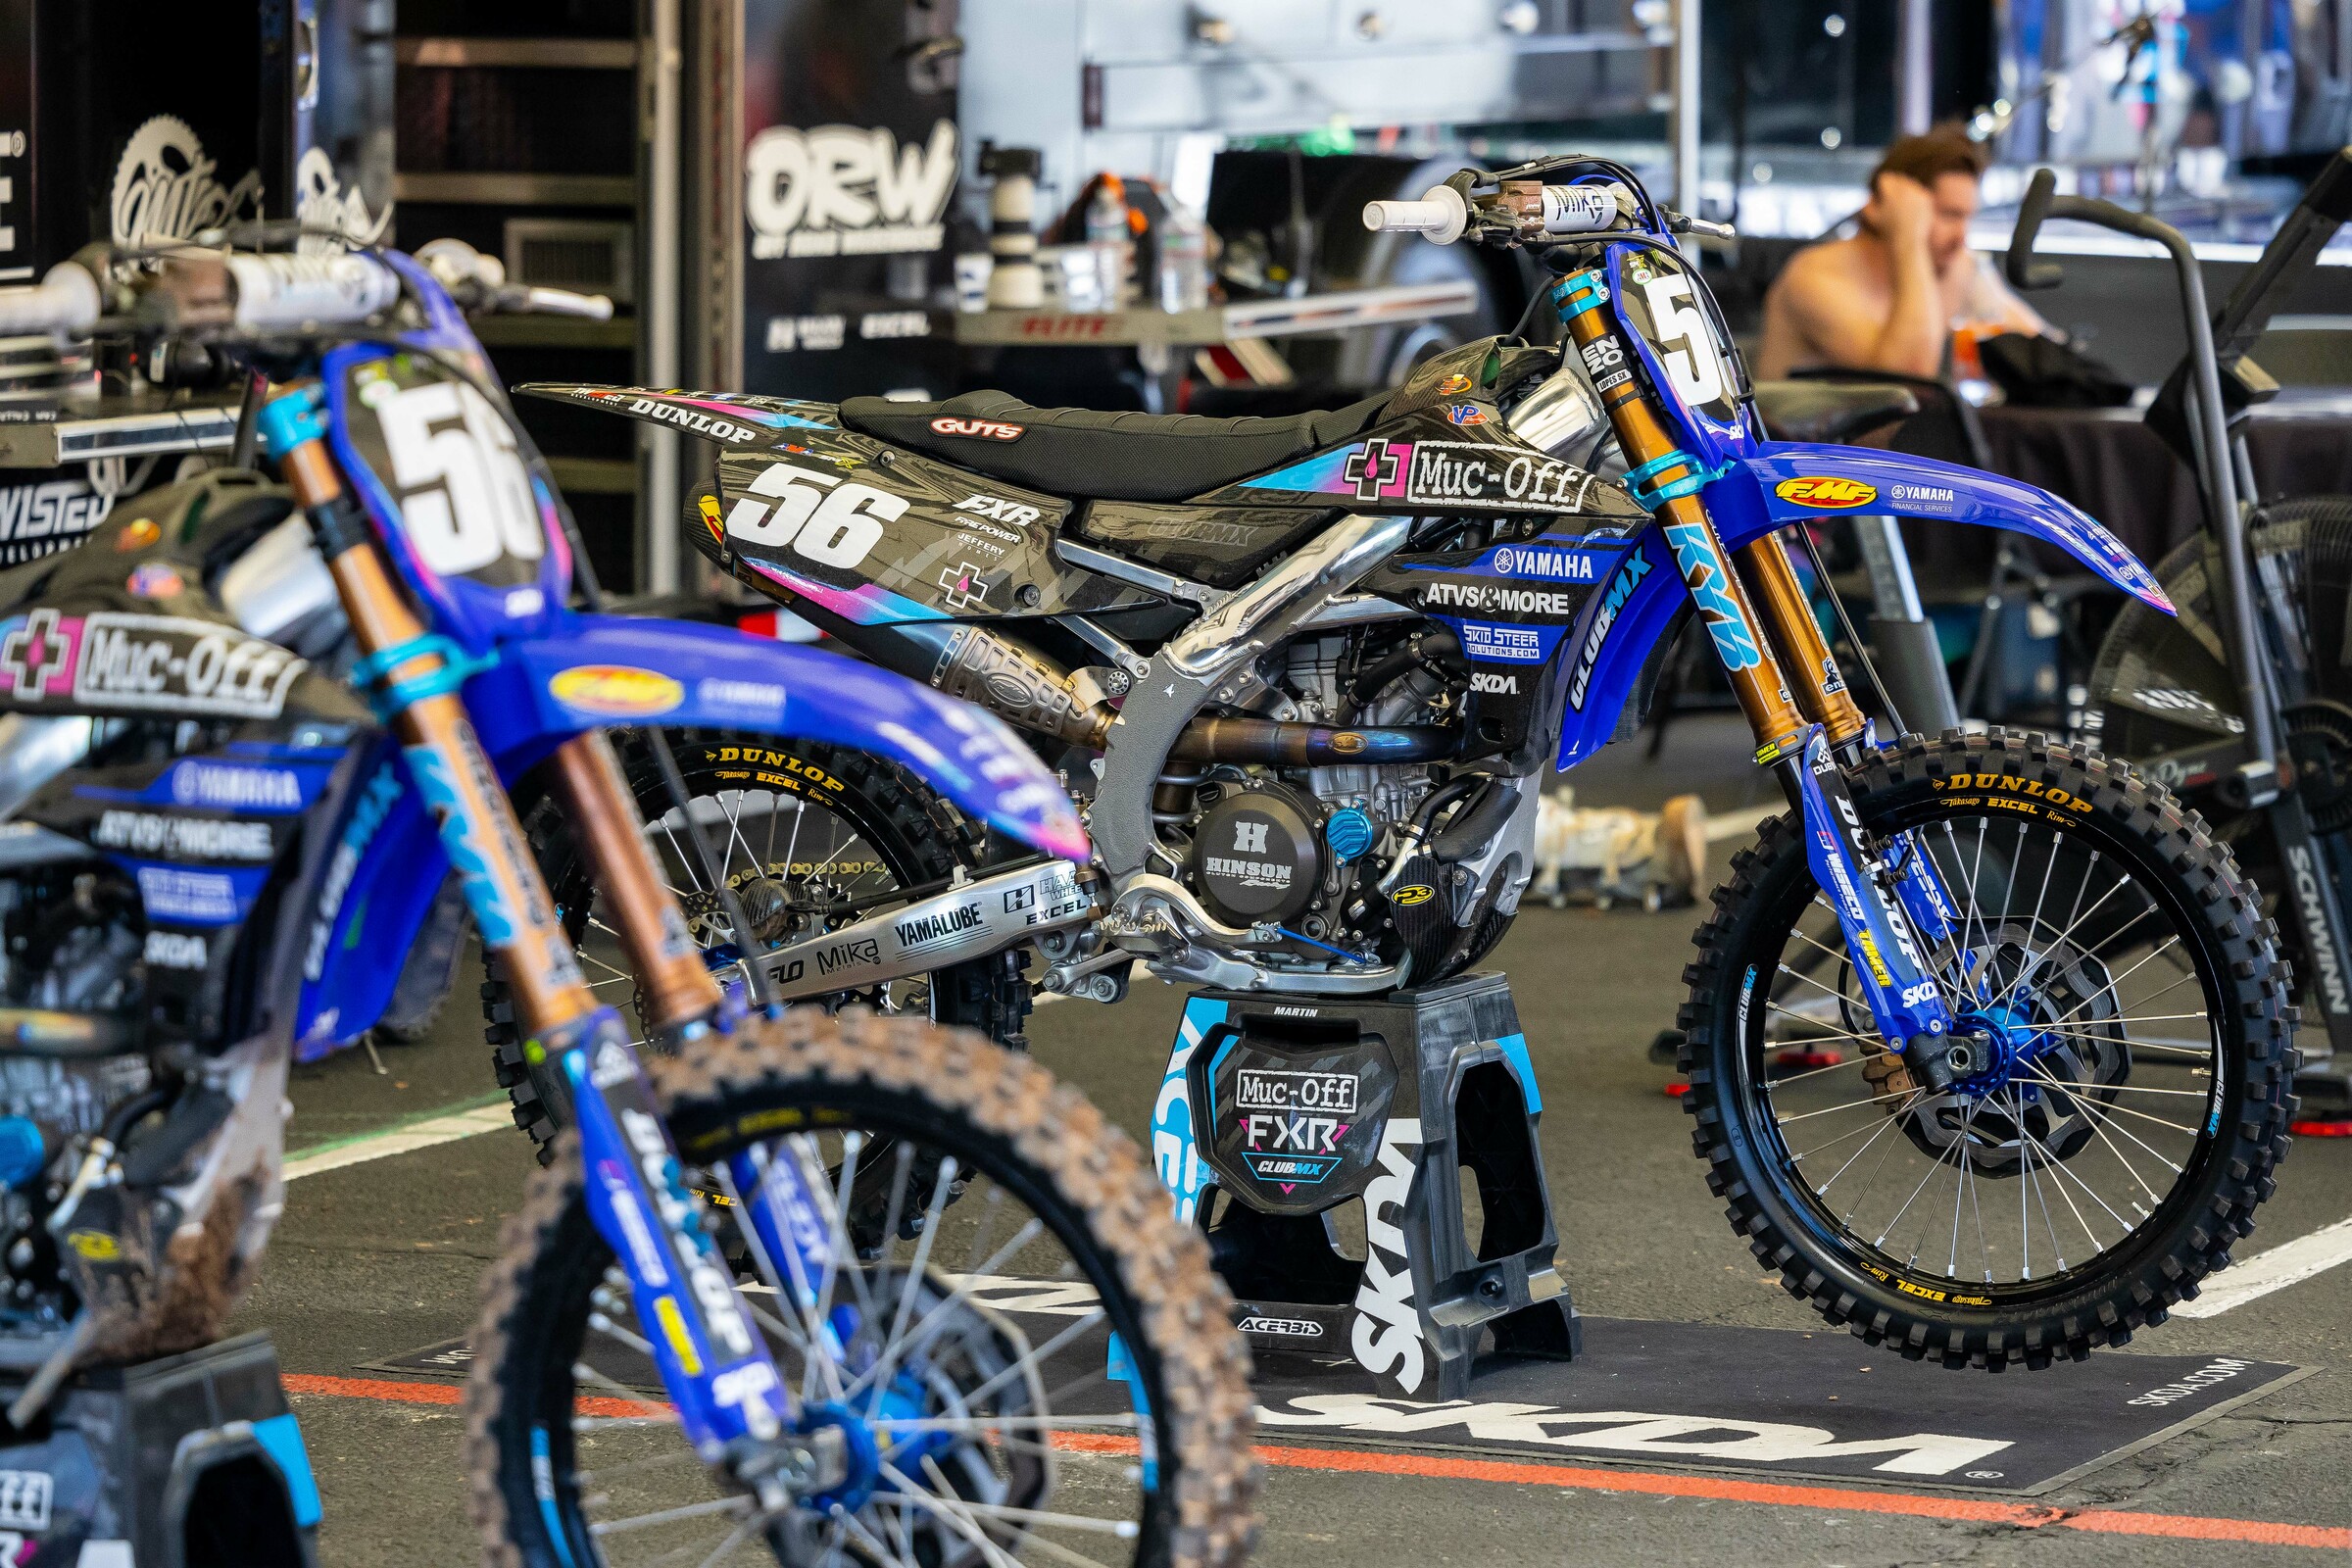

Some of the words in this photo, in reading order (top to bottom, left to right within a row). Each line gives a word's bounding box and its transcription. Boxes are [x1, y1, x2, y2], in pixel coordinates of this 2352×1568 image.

[747, 120, 958, 235] ORW
[1643, 272, 1734, 407] 5
[627, 398, 757, 443] DUNLOP
[932, 416, 1024, 440] GUTS
[1452, 405, 1480, 424] VP
[1415, 452, 1580, 503] Muc-Off
[1776, 481, 1877, 502] FMF
[1906, 486, 1954, 501] YAMAHA
[725, 462, 910, 569] 56
[952, 493, 1041, 527] FXR
[1891, 502, 1923, 512] FINANCIAL
[1924, 504, 1953, 513] SERVICES
[956, 532, 1005, 556] JEFFERY
[958, 542, 998, 562] HOMES
[1515, 550, 1593, 578] YAMAHA
[1426, 582, 1569, 613] ATVS&MORE
[1663, 522, 1762, 672] KYB
[1462, 624, 1492, 643] SKID
[1494, 627, 1540, 648] STEER
[1570, 545, 1653, 710] CLUBMX
[1469, 672, 1517, 695] SKDA
[719, 748, 845, 792] DUNLOP
[756, 771, 801, 791] EXCEL
[808, 788, 828, 805] Rim
[1948, 773, 2093, 813] DUNLOP
[1987, 797, 2038, 814] EXCEL
[2046, 810, 2070, 826] Rim
[1233, 821, 1269, 854] H
[1205, 857, 1293, 879] HINSON
[1396, 886, 1430, 905] P3
[1827, 852, 1866, 920] WISECO
[895, 904, 982, 948] YAMALUBE
[1026, 899, 1087, 926] EXCEL
[2286, 846, 2350, 1015] SCHWINN
[816, 938, 879, 975] Mika
[1858, 928, 1892, 988] TAMER
[1274, 1006, 1318, 1018] MARTIN
[1241, 1076, 1352, 1108] Muc-Off
[1247, 1114, 1339, 1152] FXR
[1257, 1160, 1323, 1176] CLUBMX
[1351, 1117, 1426, 1396] SKDA
[1896, 1278, 1947, 1302] EXCEL
[1239, 1316, 1323, 1337] ACERBIS
[2126, 1357, 2255, 1406] SKDA.COM
